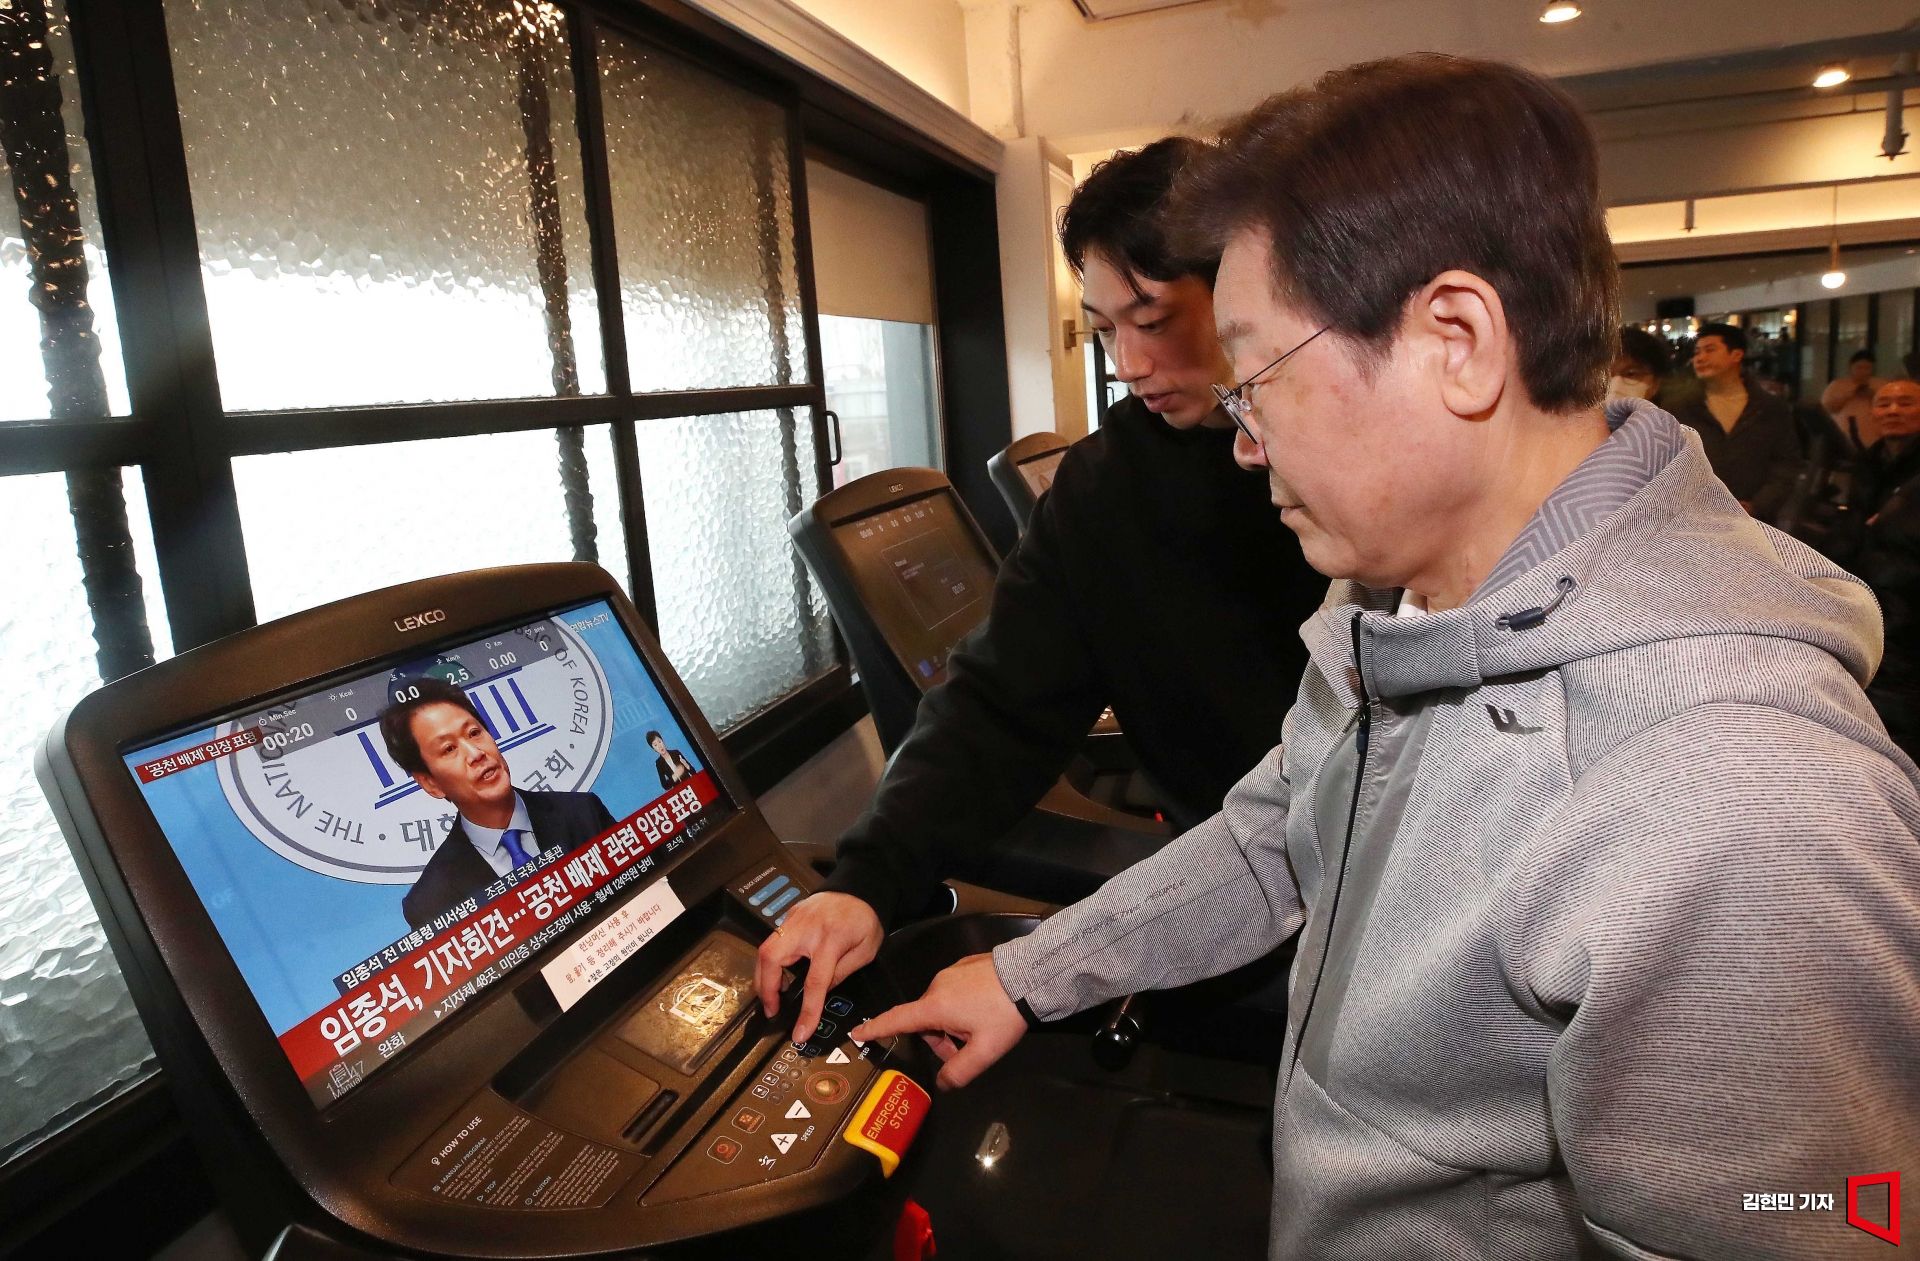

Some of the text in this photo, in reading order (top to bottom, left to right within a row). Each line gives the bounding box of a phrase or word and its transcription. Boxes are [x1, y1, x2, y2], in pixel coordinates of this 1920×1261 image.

[394, 609, 446, 632] LEXCO
[570, 613, 609, 633] 연합뉴스TV
[540, 640, 549, 651] 0
[488, 651, 517, 670] 0.00
[446, 668, 469, 686] 2.5
[339, 689, 354, 699] Kcal
[395, 685, 420, 703] 0.0
[345, 707, 358, 721] 0
[262, 722, 314, 750] 00:20
[314, 809, 365, 845] THE
[554, 648, 577, 669] OF
[569, 677, 589, 735] KOREA
[144, 730, 257, 778] '공천 배제' 입장 표명
[484, 844, 565, 900] 조금 전 국회 소통관
[320, 974, 423, 1057] 임종석,
[601, 824, 645, 867] 관련
[636, 804, 674, 845] 입장
[667, 784, 702, 823] 표명
[579, 928, 606, 952] 런닝머신
[607, 917, 621, 931] 사용
[586, 955, 596, 966] 등
[596, 938, 618, 957] 정리해
[617, 923, 638, 941] 주시기
[637, 903, 662, 925] 바랍니다
[341, 896, 479, 989] 임종석 전 대통령 비서실장
[440, 981, 477, 1013] 지자체
[476, 966, 502, 989] 48곳,
[499, 947, 530, 971] 미인증
[529, 913, 574, 950] 상수도장비
[611, 865, 640, 891] 124억원
[638, 928, 655, 942] 됩니다
[378, 1031, 407, 1059] 완화
[858, 1046, 871, 1062] SPEED
[866, 1078, 910, 1141] EMERGENCY
[889, 1099, 911, 1130] STOP
[439, 1116, 483, 1158] HOW TO USE
[800, 1125, 815, 1142] SPEED
